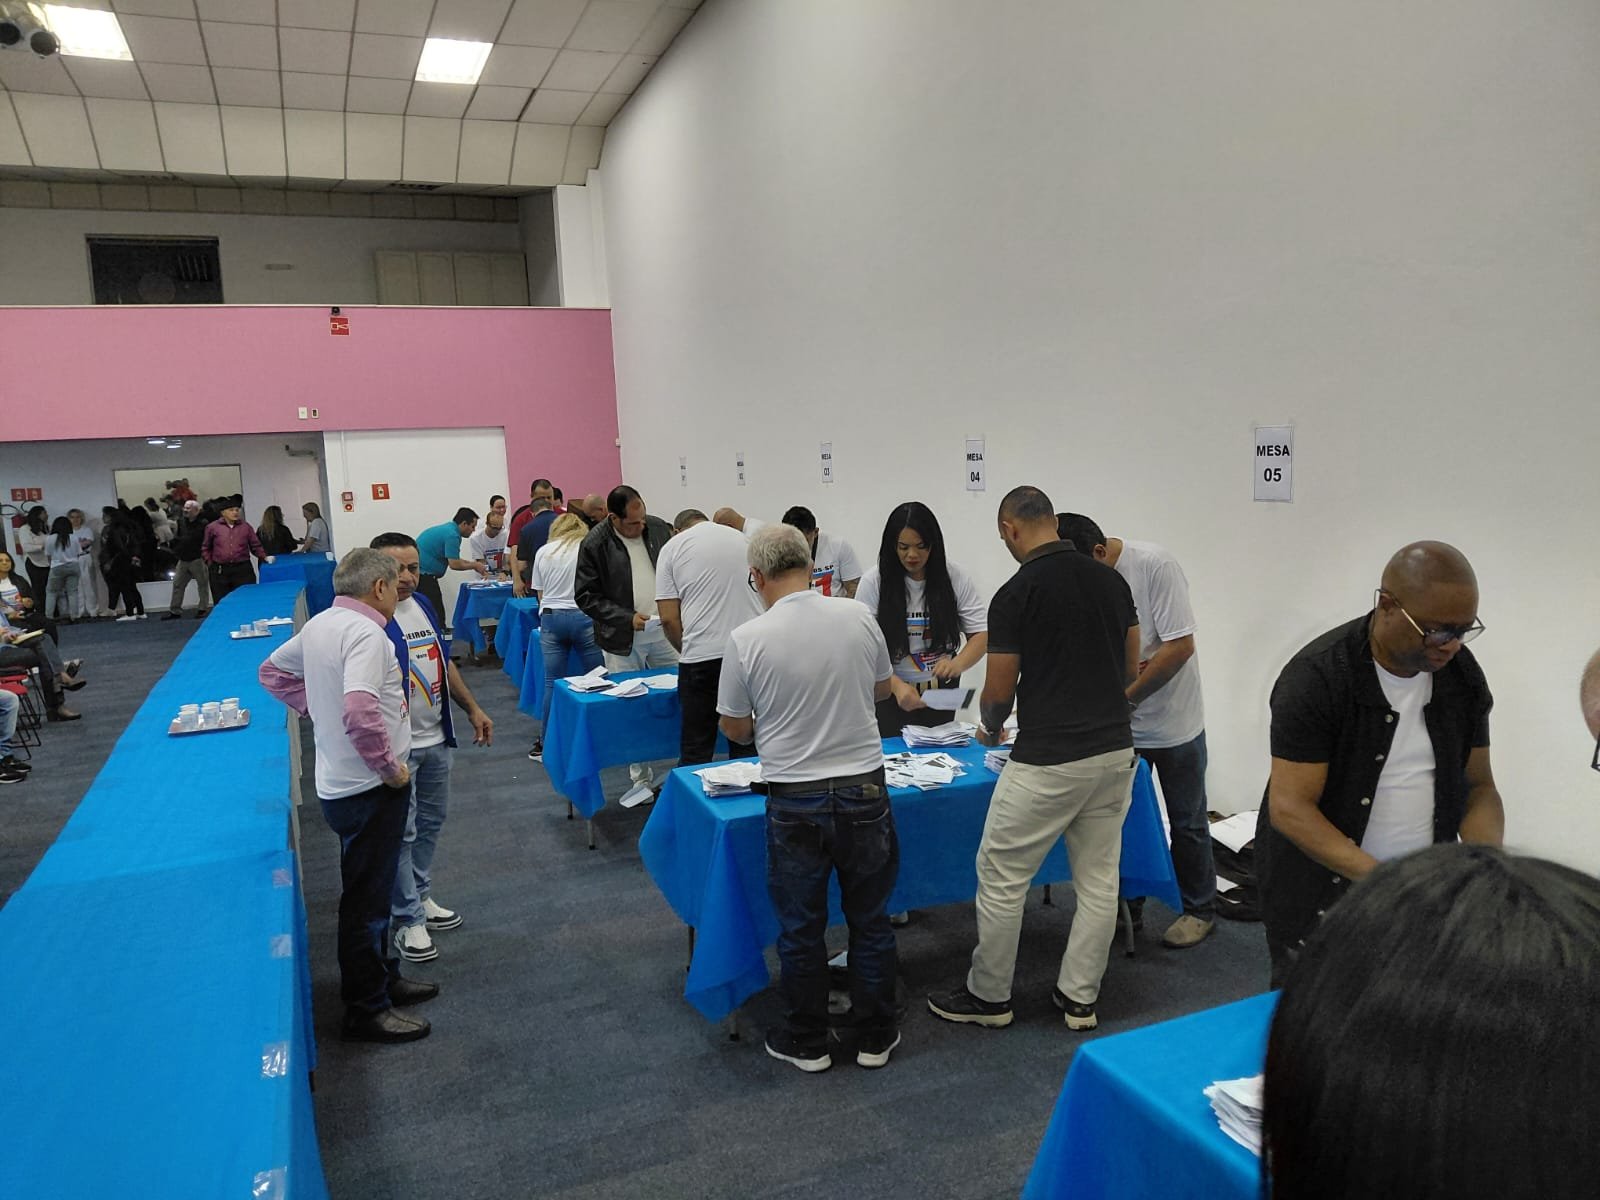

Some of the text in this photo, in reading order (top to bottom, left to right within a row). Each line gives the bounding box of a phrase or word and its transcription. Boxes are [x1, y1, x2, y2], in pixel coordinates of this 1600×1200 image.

[1256, 444, 1290, 457] MESA
[966, 453, 983, 461] MESA
[970, 471, 980, 482] 04
[1263, 467, 1282, 482] 05
